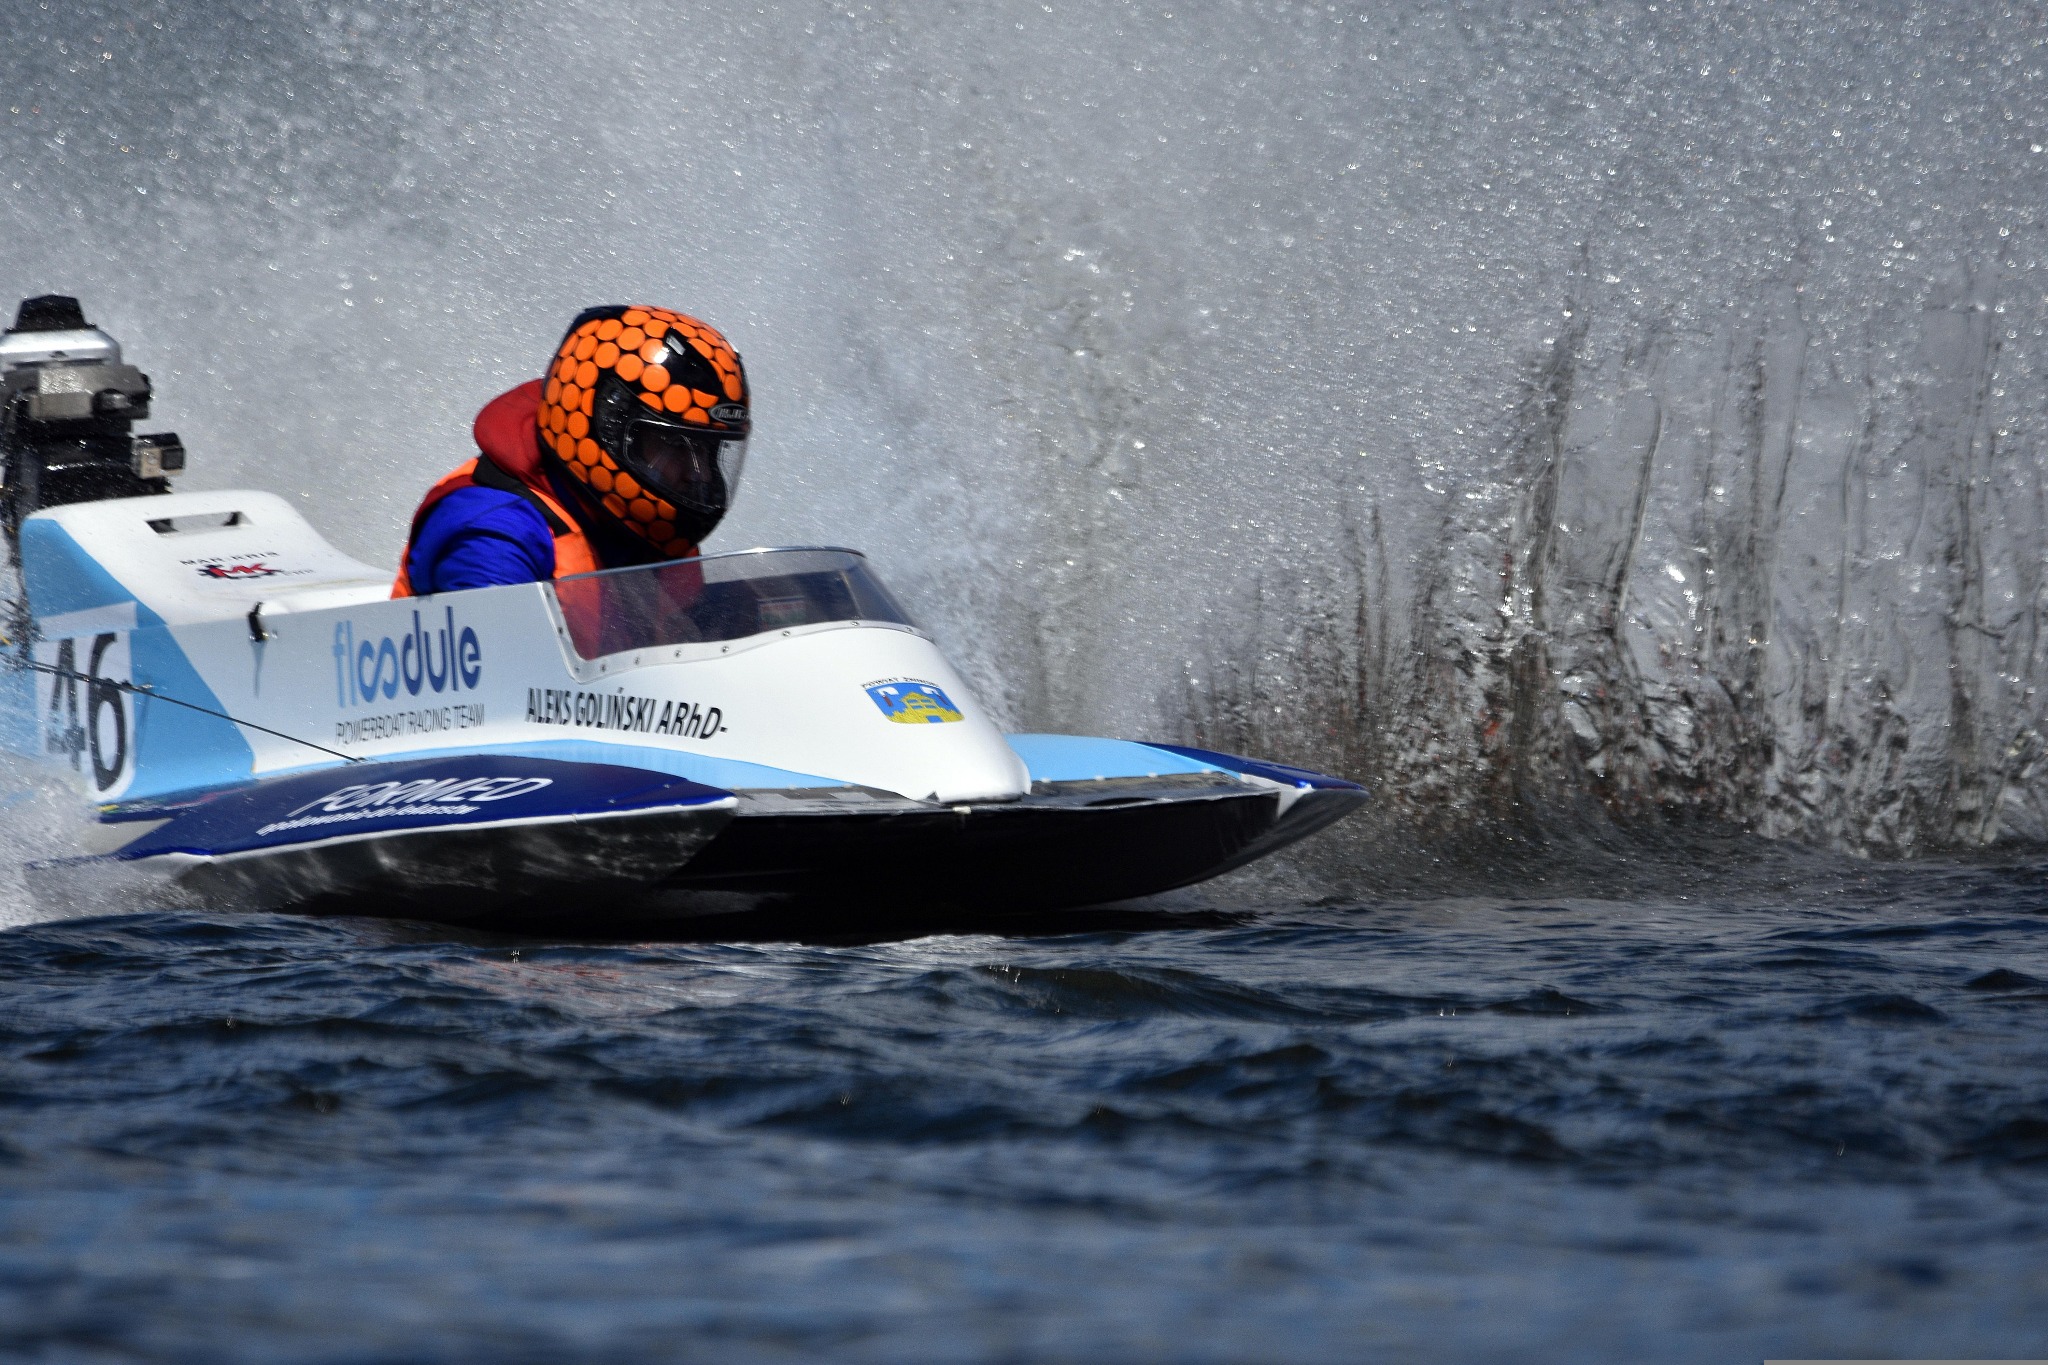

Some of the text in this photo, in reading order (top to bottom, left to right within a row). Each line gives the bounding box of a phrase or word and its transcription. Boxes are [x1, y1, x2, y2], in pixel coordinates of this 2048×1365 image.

[47, 631, 128, 792] 46
[334, 702, 485, 746] POWERBOAT RACING TEAM
[525, 687, 572, 726] ALEKS
[573, 686, 657, 733] GOLIŃSKI
[285, 777, 554, 818] FORMED
